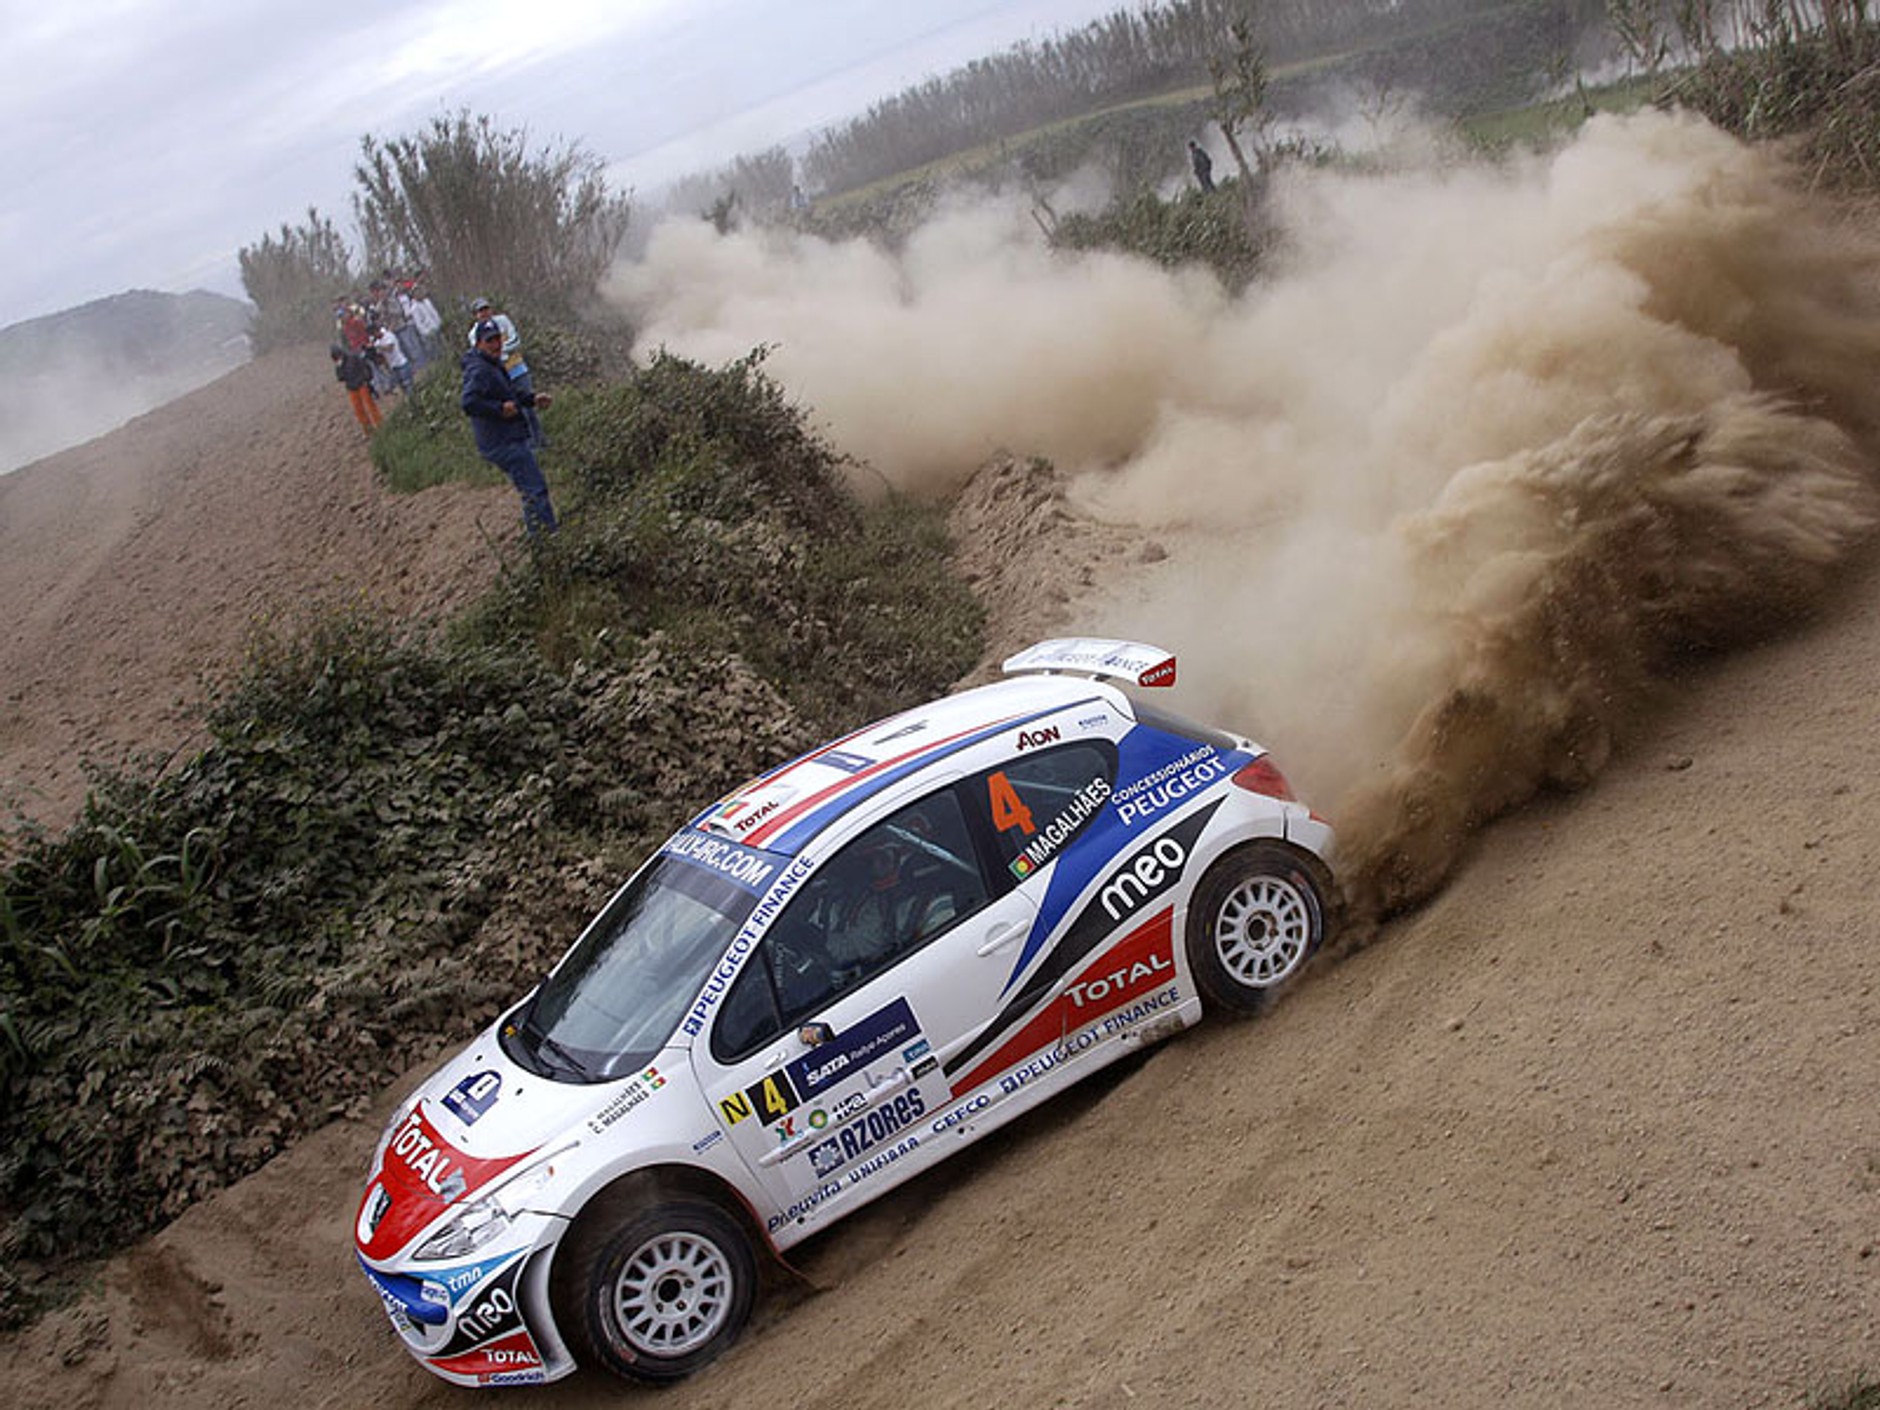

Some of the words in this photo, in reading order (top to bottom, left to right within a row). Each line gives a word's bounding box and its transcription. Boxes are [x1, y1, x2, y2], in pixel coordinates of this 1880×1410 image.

[1016, 726, 1061, 750] AON
[734, 799, 780, 833] TOTAL
[988, 771, 1036, 836] 4
[1117, 756, 1227, 826] PEUGEOT
[1025, 777, 1111, 865] MAGALHÃES
[1100, 837, 1185, 920] meo
[693, 927, 757, 1020] PEUGEOT
[752, 855, 815, 926] FINANCE
[1064, 954, 1171, 1007] TOTAL
[1016, 1030, 1099, 1086] PEUGEOT
[1104, 987, 1180, 1034] FINANCE
[763, 1076, 788, 1118] 4
[806, 1055, 850, 1087] SATA
[720, 1092, 751, 1125] N
[391, 1112, 451, 1195] TOTAL
[448, 1267, 482, 1293] tmn
[481, 1350, 541, 1365] TOTAL
